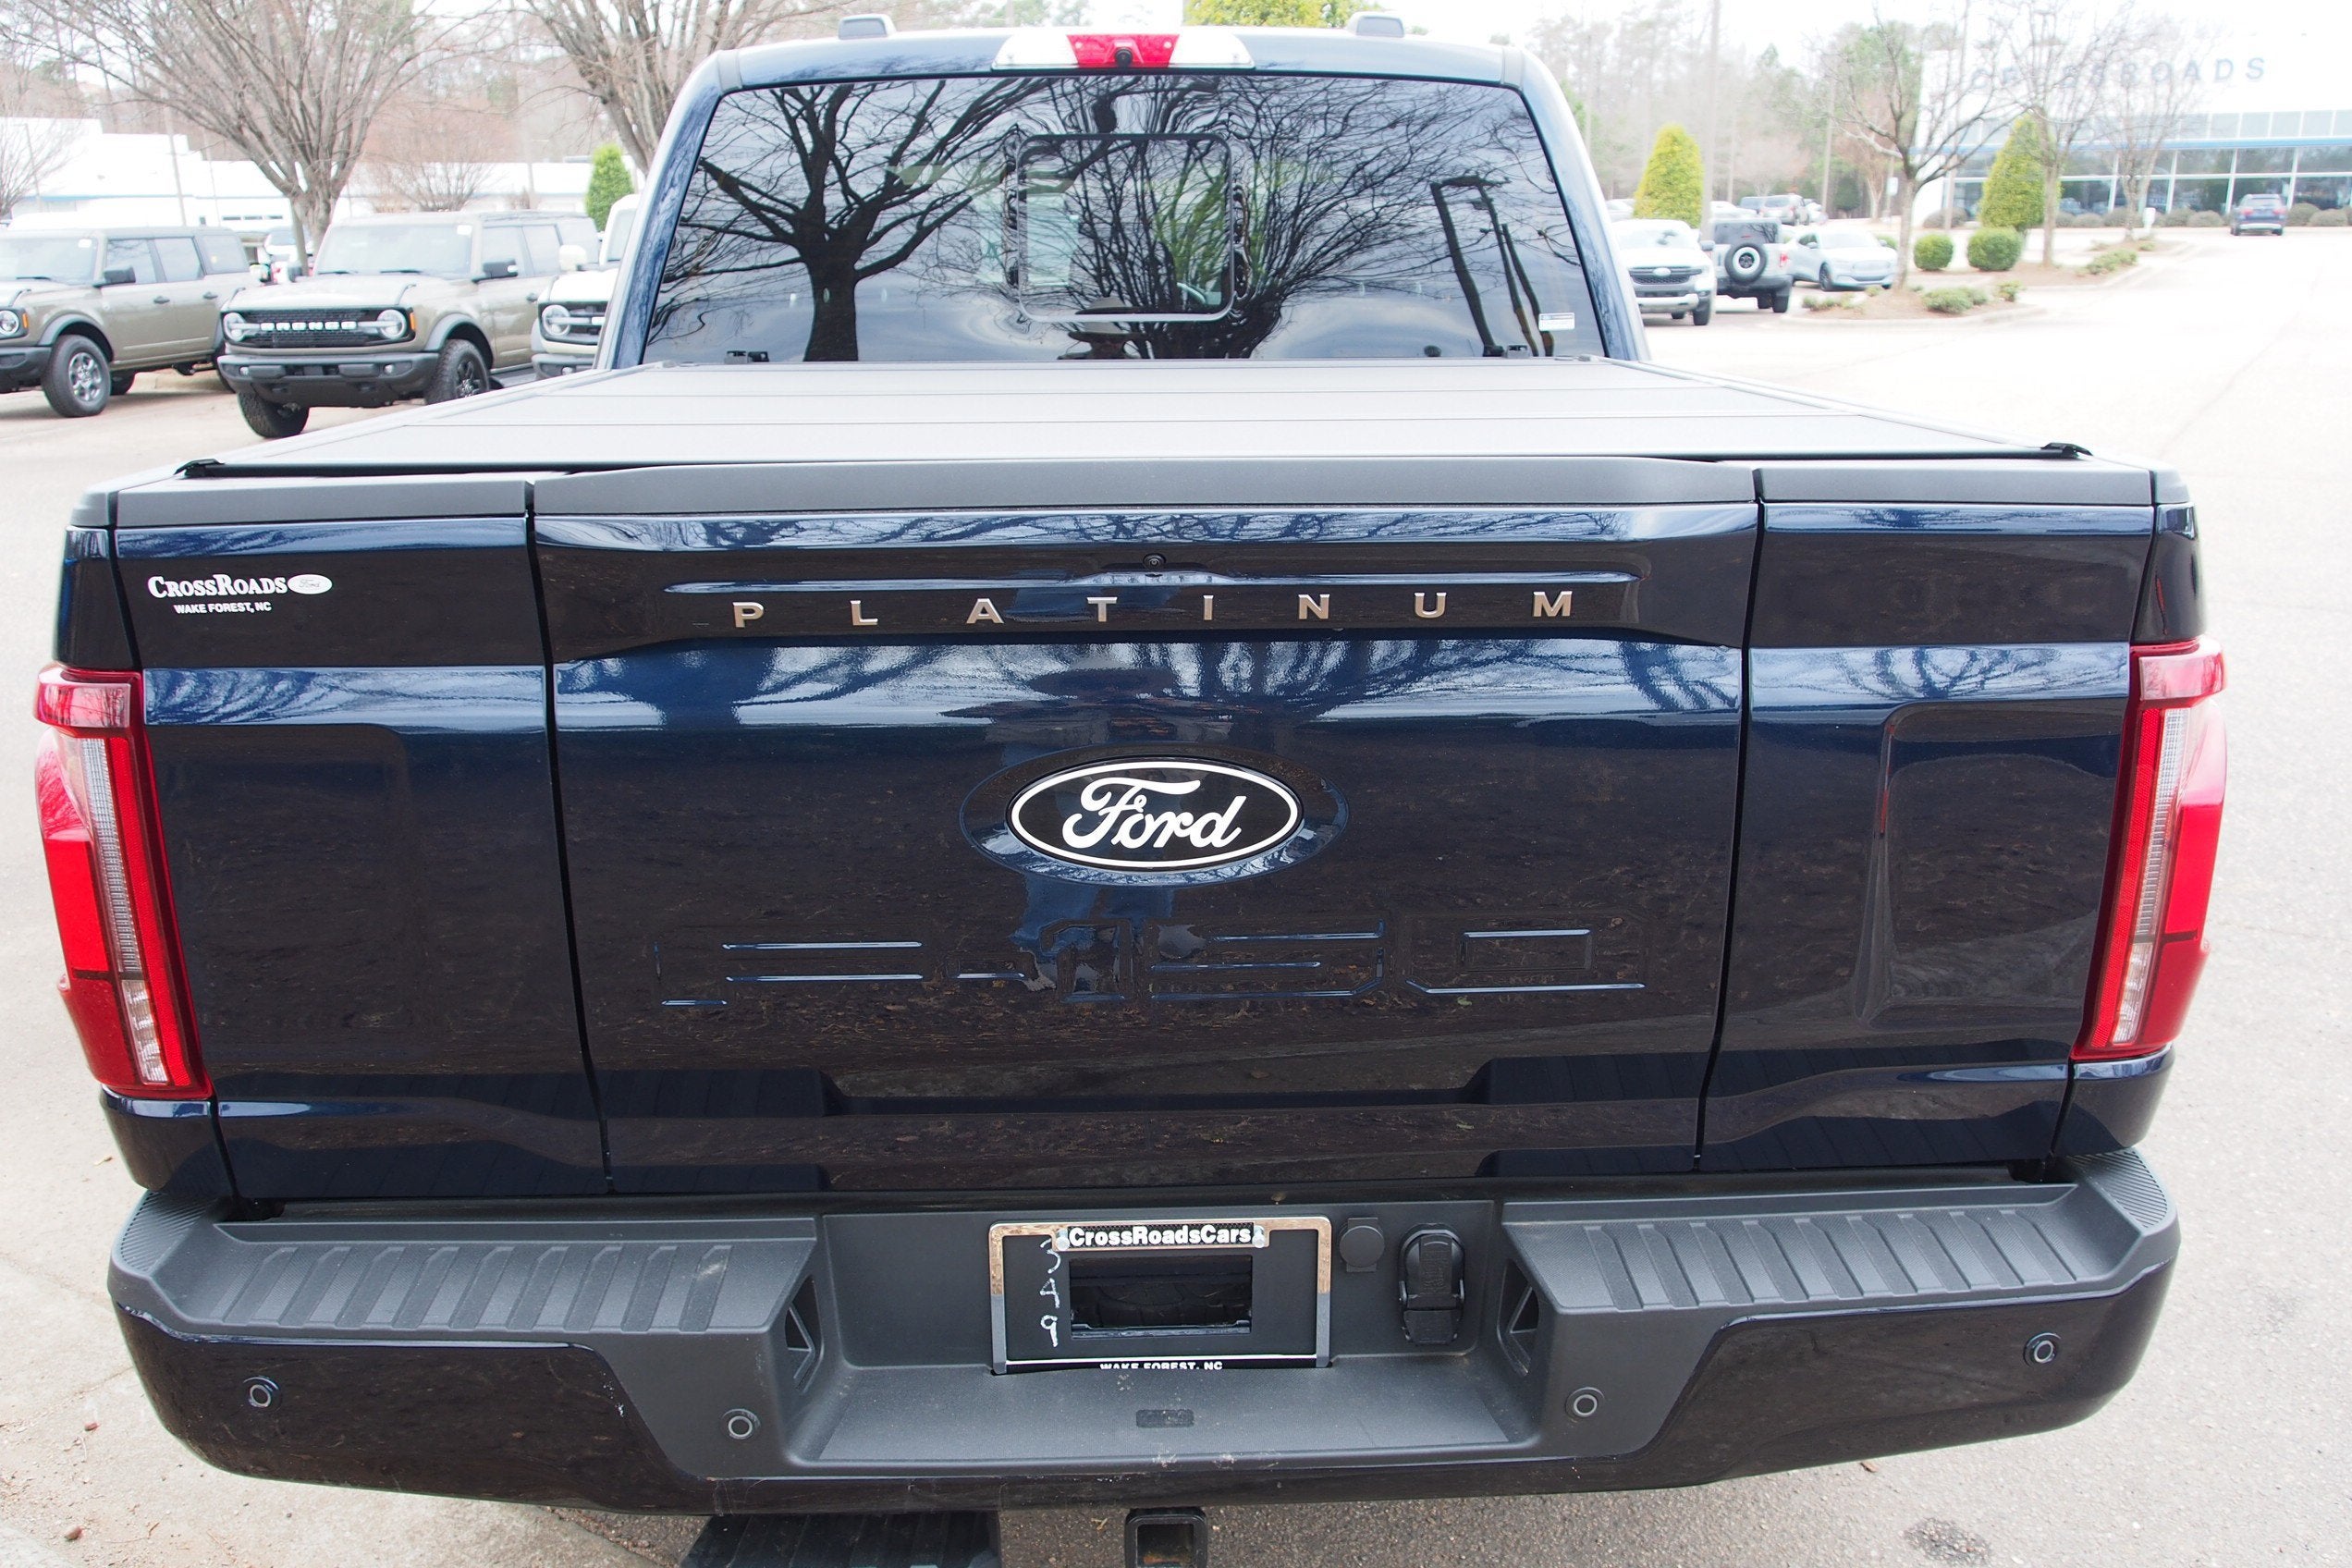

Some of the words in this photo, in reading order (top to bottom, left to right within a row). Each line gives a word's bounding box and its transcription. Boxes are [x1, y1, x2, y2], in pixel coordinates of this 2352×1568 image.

[260, 322, 357, 331] BRONCO
[173, 604, 207, 614] WAKE
[208, 602, 254, 614] FOREST,
[255, 601, 272, 612] NC
[731, 590, 1574, 630] PLATINUM
[1062, 777, 1247, 849] Ford
[1069, 1224, 1252, 1247] CrossRoadsCars
[1203, 1360, 1223, 1371] NC
